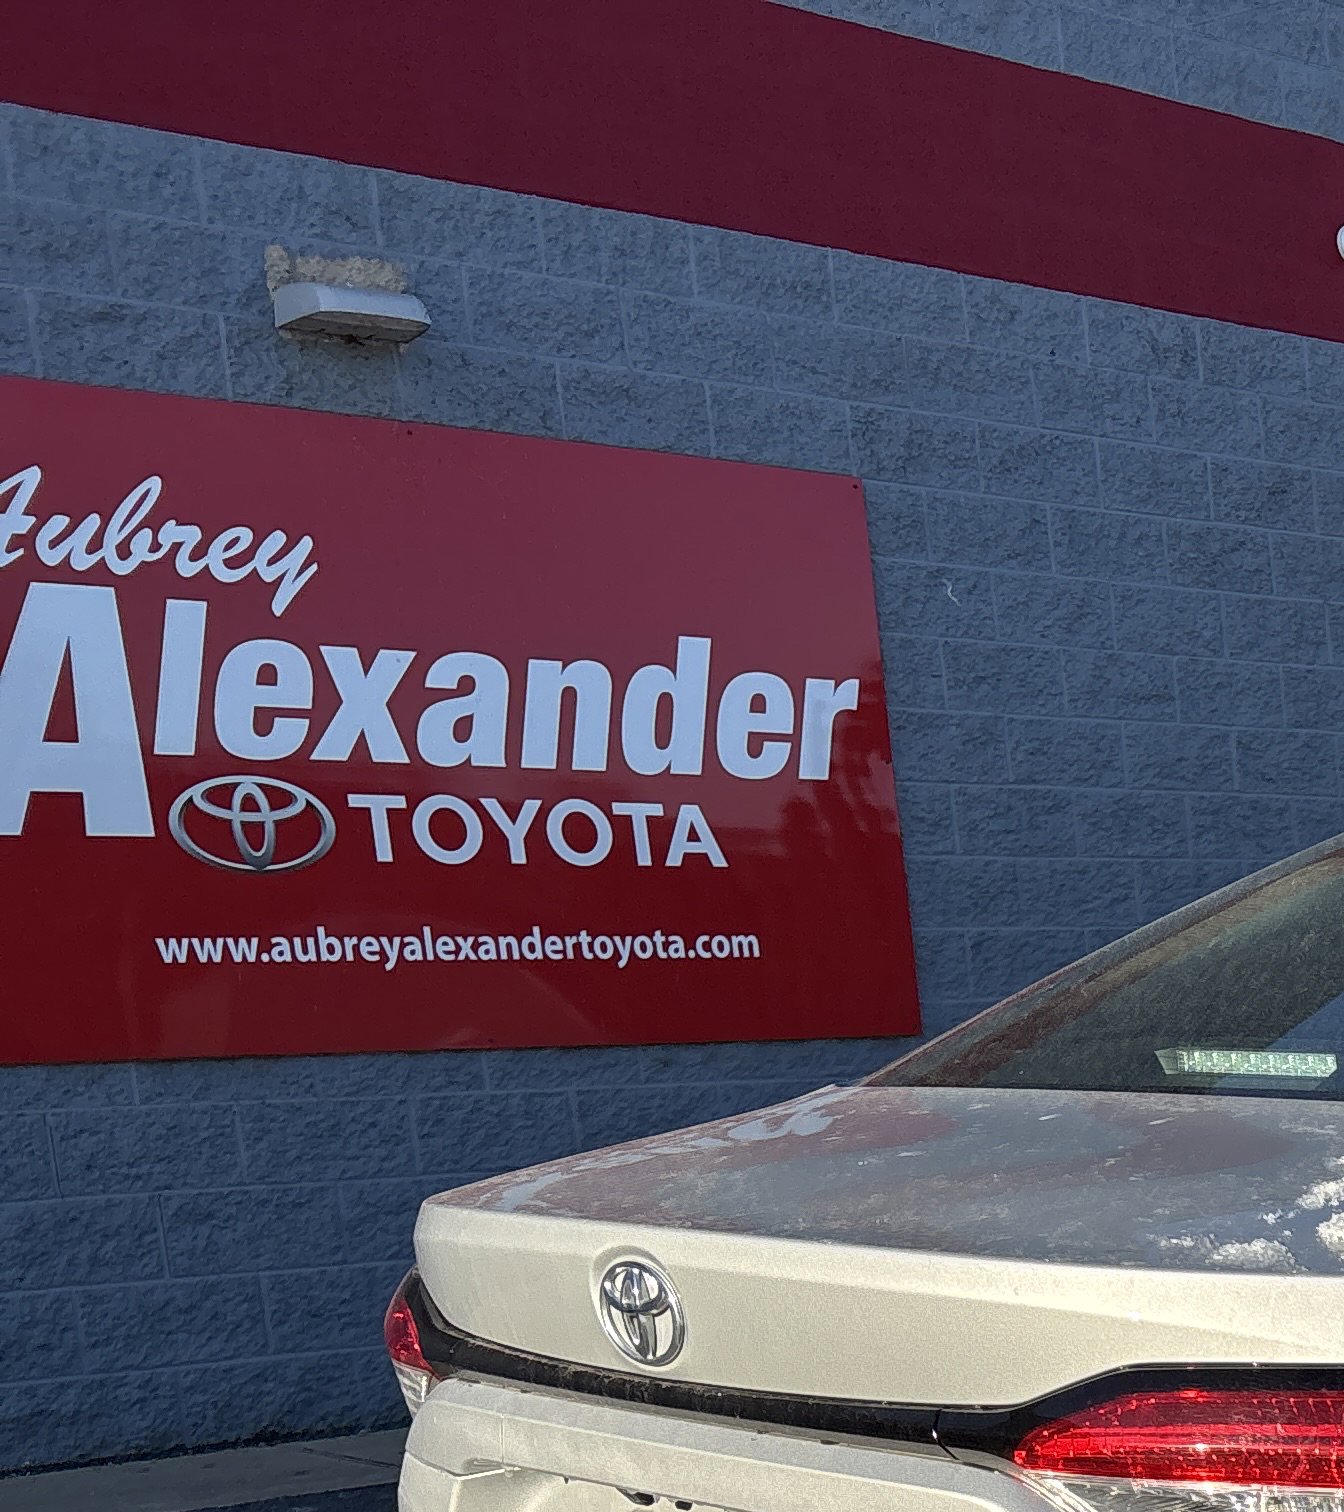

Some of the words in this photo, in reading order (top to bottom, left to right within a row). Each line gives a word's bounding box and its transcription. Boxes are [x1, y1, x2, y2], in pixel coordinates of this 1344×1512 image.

[0, 581, 860, 838] Alexander
[347, 793, 730, 869] TOYOTA
[155, 926, 761, 972] www.aubreyalexandertoyota.com
